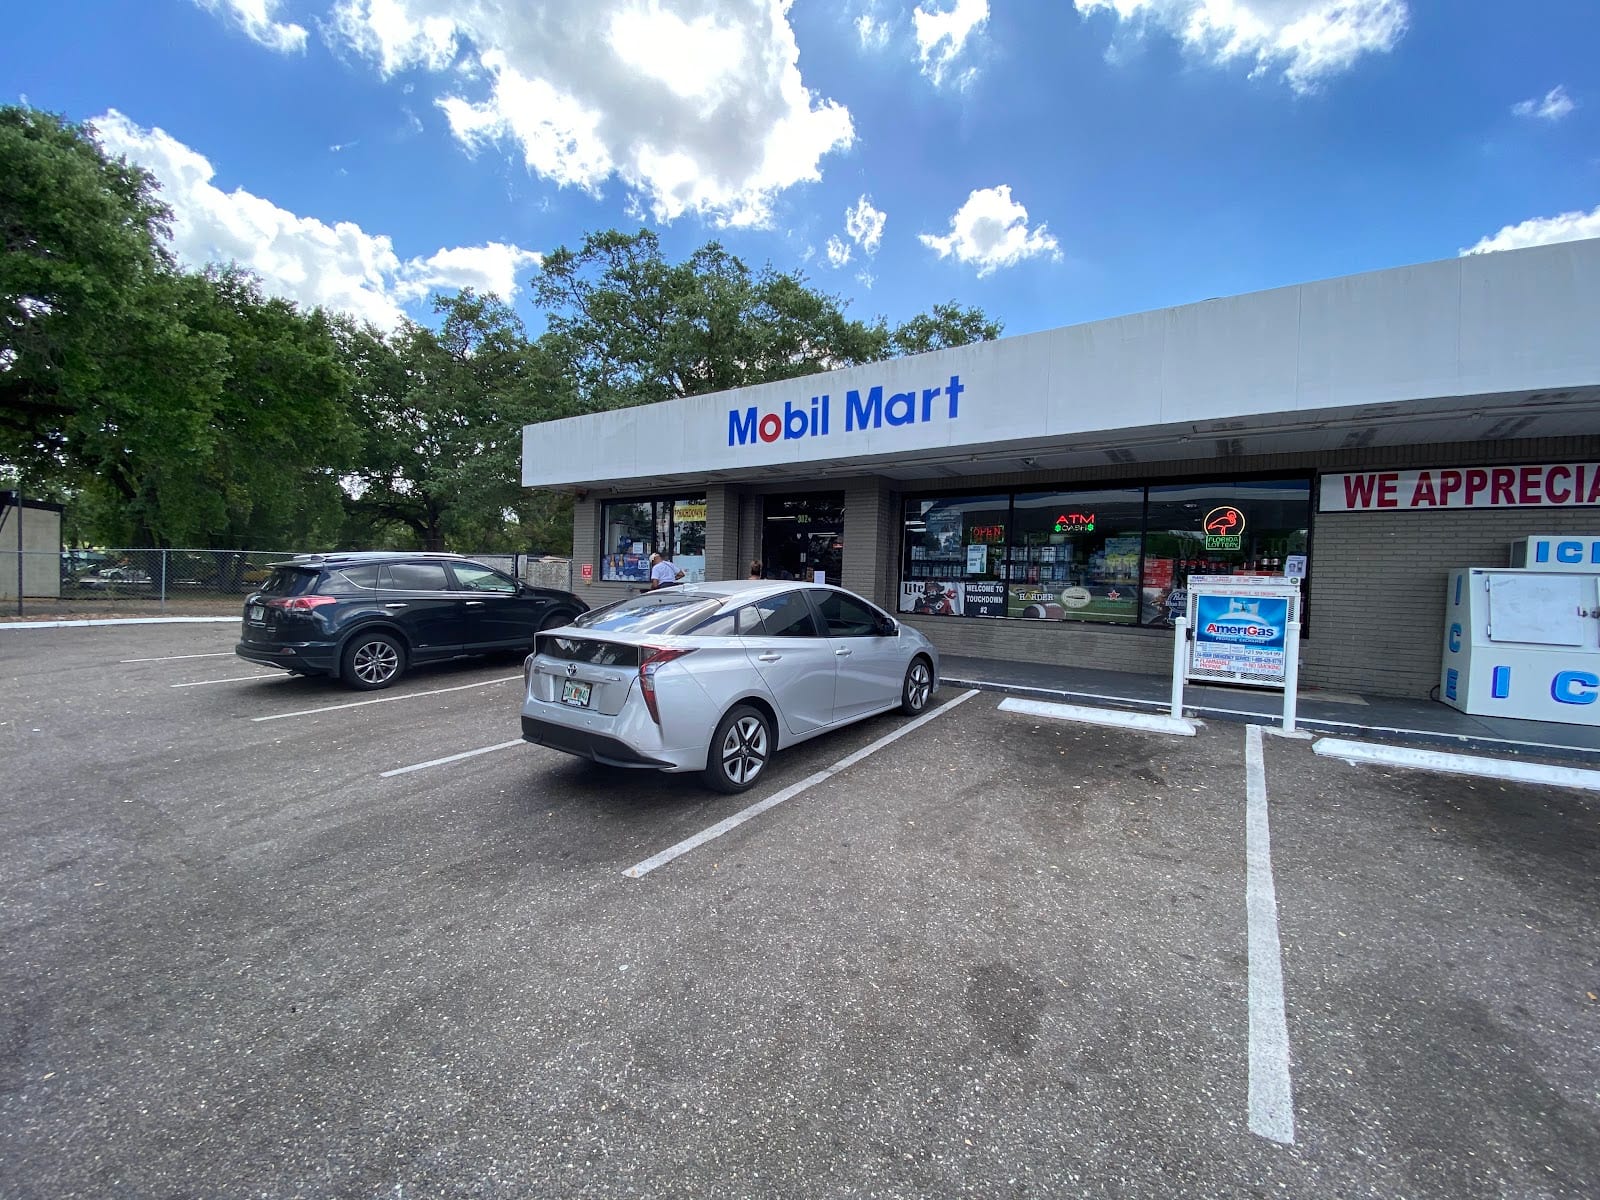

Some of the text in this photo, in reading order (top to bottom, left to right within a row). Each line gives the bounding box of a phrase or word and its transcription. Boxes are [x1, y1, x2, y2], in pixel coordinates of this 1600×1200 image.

[728, 375, 964, 446] Mobil Mart
[1344, 473, 1398, 508] WE
[1056, 514, 1095, 524] ATM
[973, 527, 1001, 536] OPEN
[904, 583, 924, 594] Lite
[966, 584, 1004, 593] WELCOME TO
[966, 595, 1003, 604] TOUCHDOWN
[980, 606, 987, 614] #2
[1206, 623, 1274, 637] AmeriGas
[1446, 575, 1462, 700] ICE
